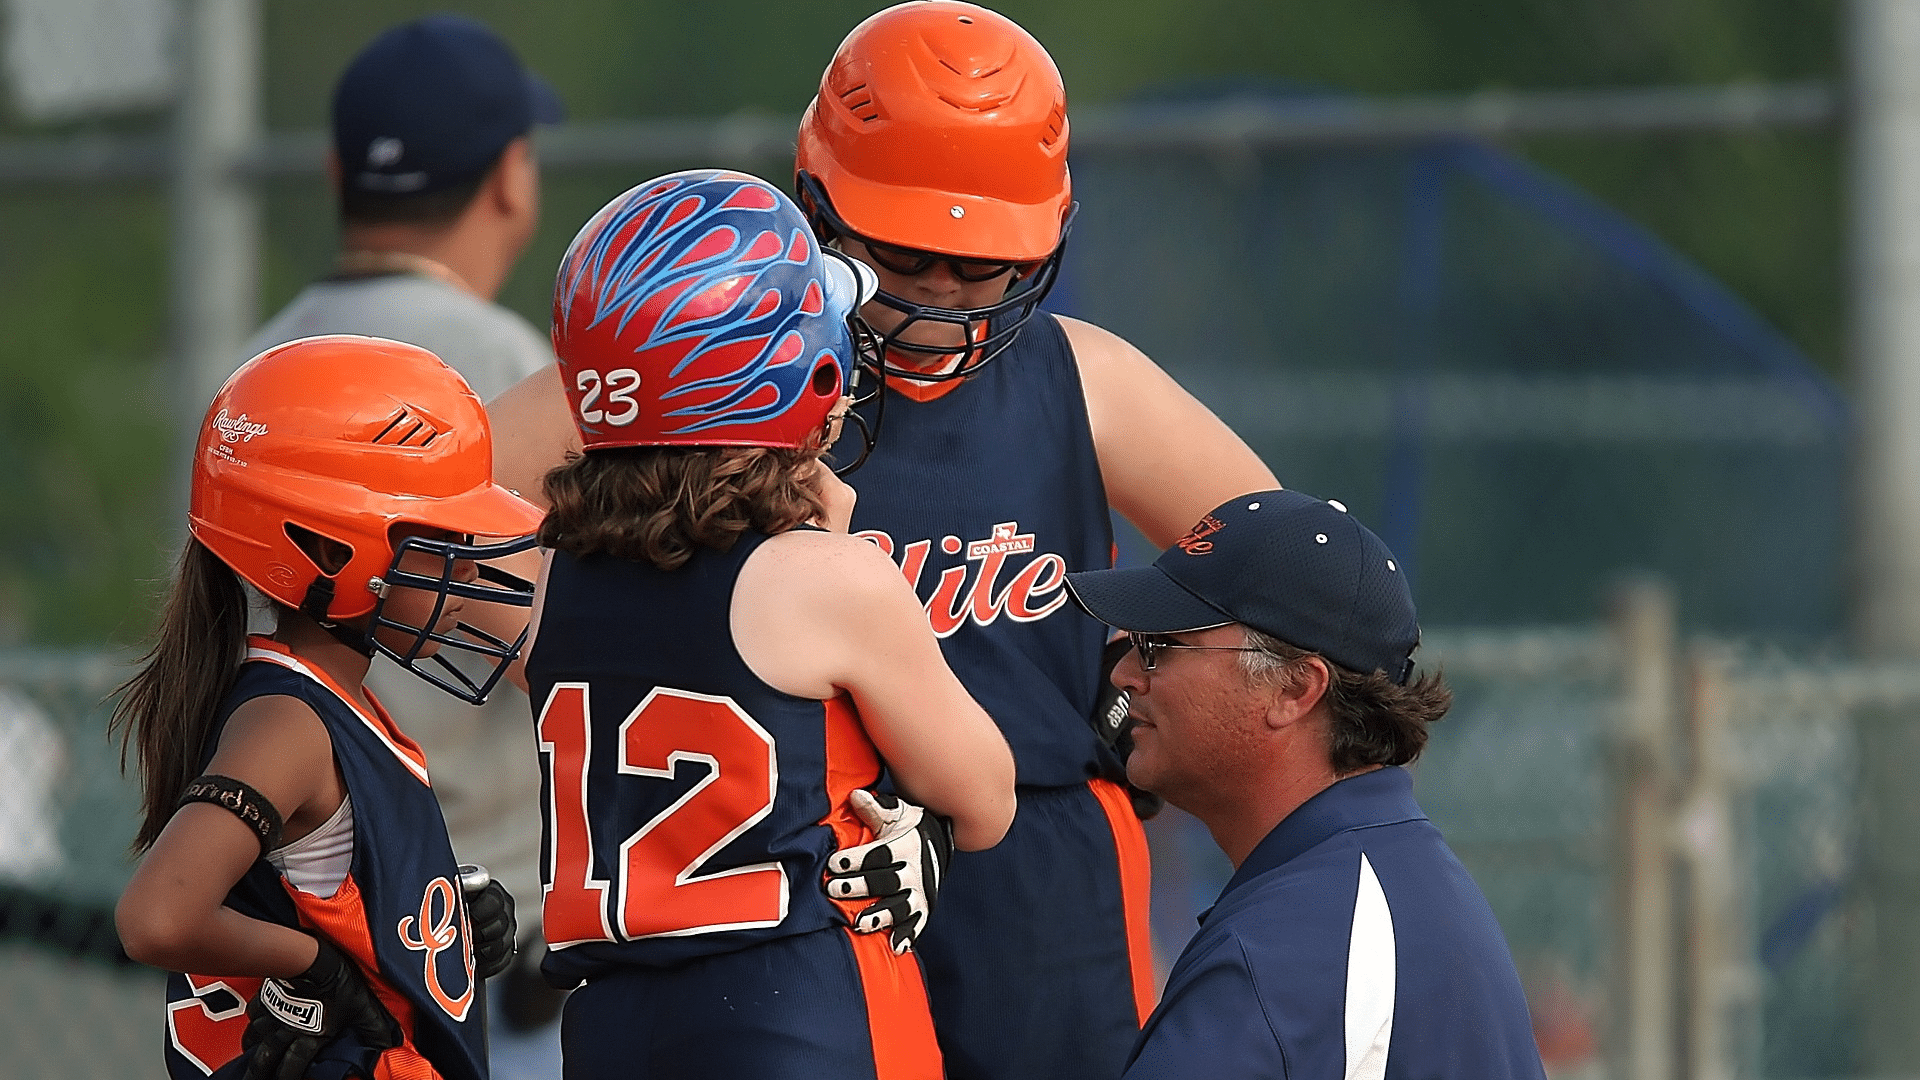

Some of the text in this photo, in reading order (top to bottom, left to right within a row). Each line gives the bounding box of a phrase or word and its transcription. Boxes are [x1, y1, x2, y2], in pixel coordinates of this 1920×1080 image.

[577, 368, 641, 426] 23
[213, 408, 269, 443] Rawlings
[973, 540, 1031, 556] COASTAL
[537, 677, 790, 951] 12
